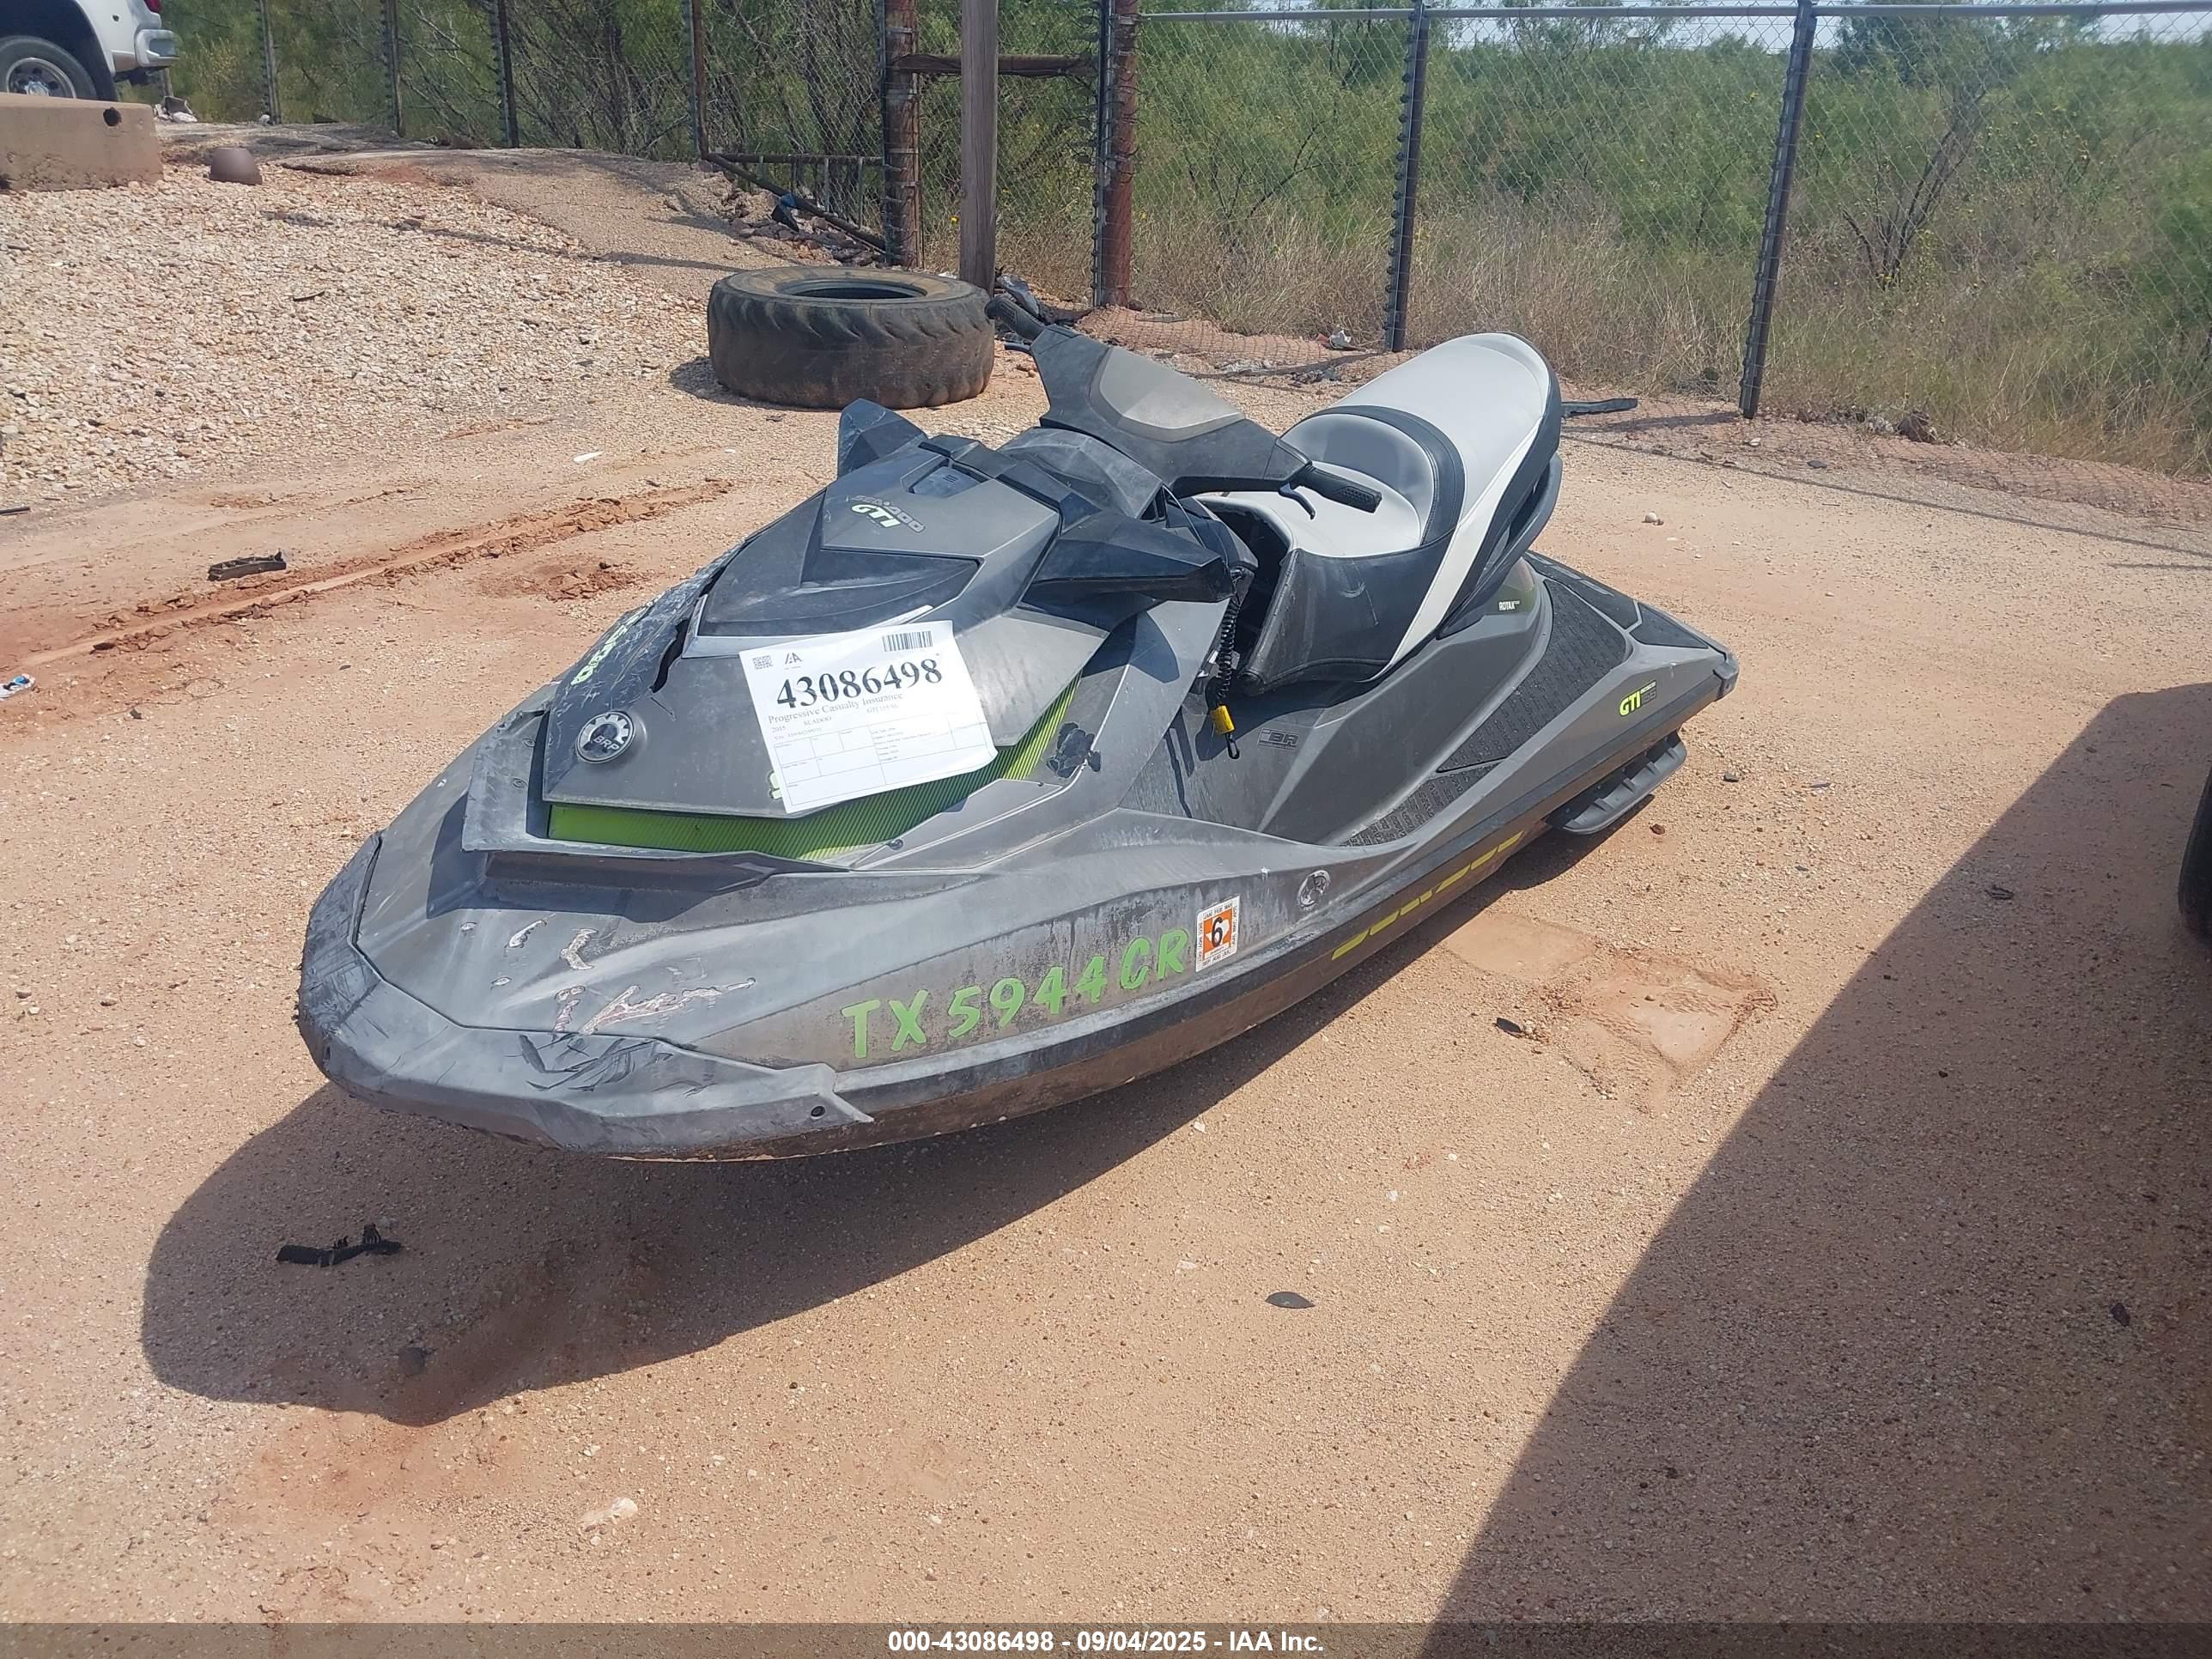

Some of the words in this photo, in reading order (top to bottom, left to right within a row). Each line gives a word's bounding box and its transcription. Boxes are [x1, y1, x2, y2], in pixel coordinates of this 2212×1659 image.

[851, 504, 901, 528] GTI
[776, 658, 943, 708] 43086498
[768, 707, 821, 725] Progressive
[822, 699, 860, 714] Casualty
[861, 693, 903, 706] Insurance
[1620, 690, 1641, 716] GTI
[593, 734, 620, 751] BRP
[1212, 916, 1224, 948] 6
[842, 989, 928, 1059] TX
[947, 956, 1108, 1039] 5944
[1120, 928, 1191, 990] CR
